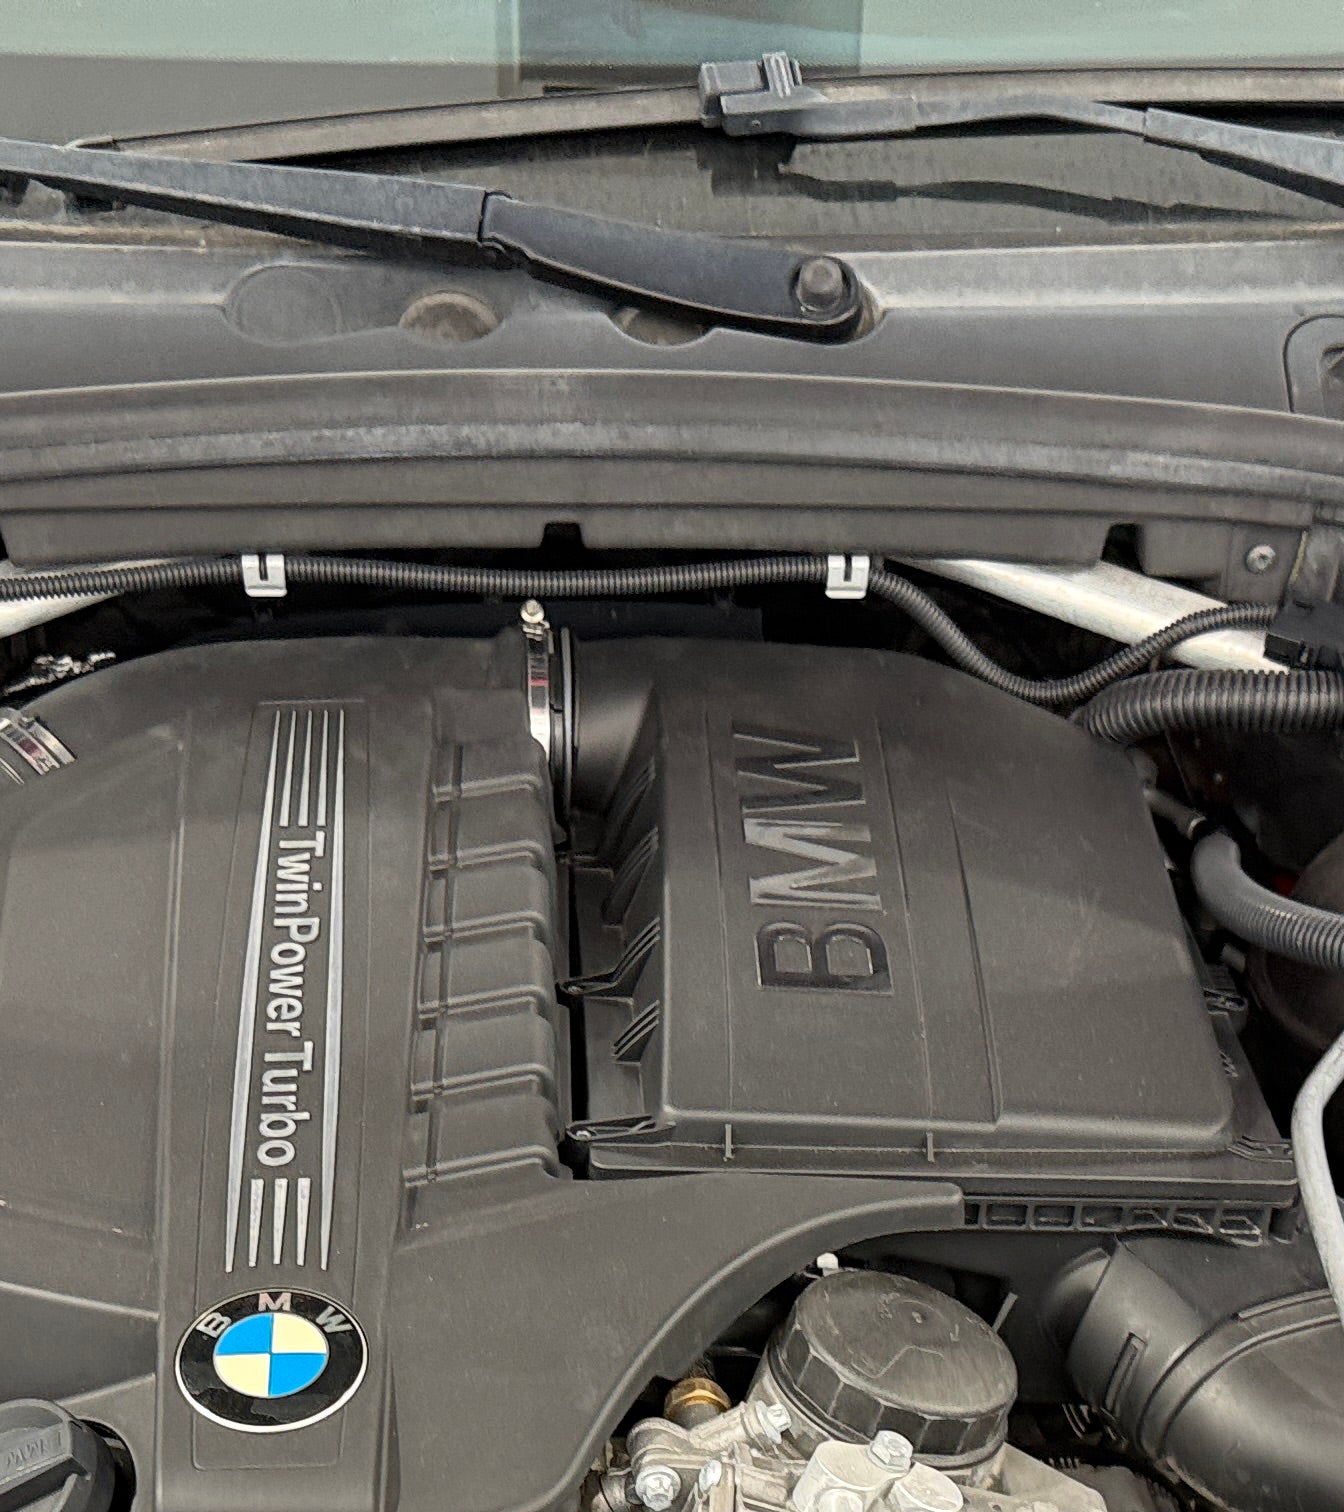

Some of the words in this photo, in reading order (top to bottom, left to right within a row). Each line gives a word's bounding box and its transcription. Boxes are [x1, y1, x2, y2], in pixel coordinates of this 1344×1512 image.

[266, 830, 326, 1037] TwinPower
[732, 731, 895, 997] BMW
[256, 1040, 314, 1167] Turbo
[196, 1292, 353, 1338] BMW
